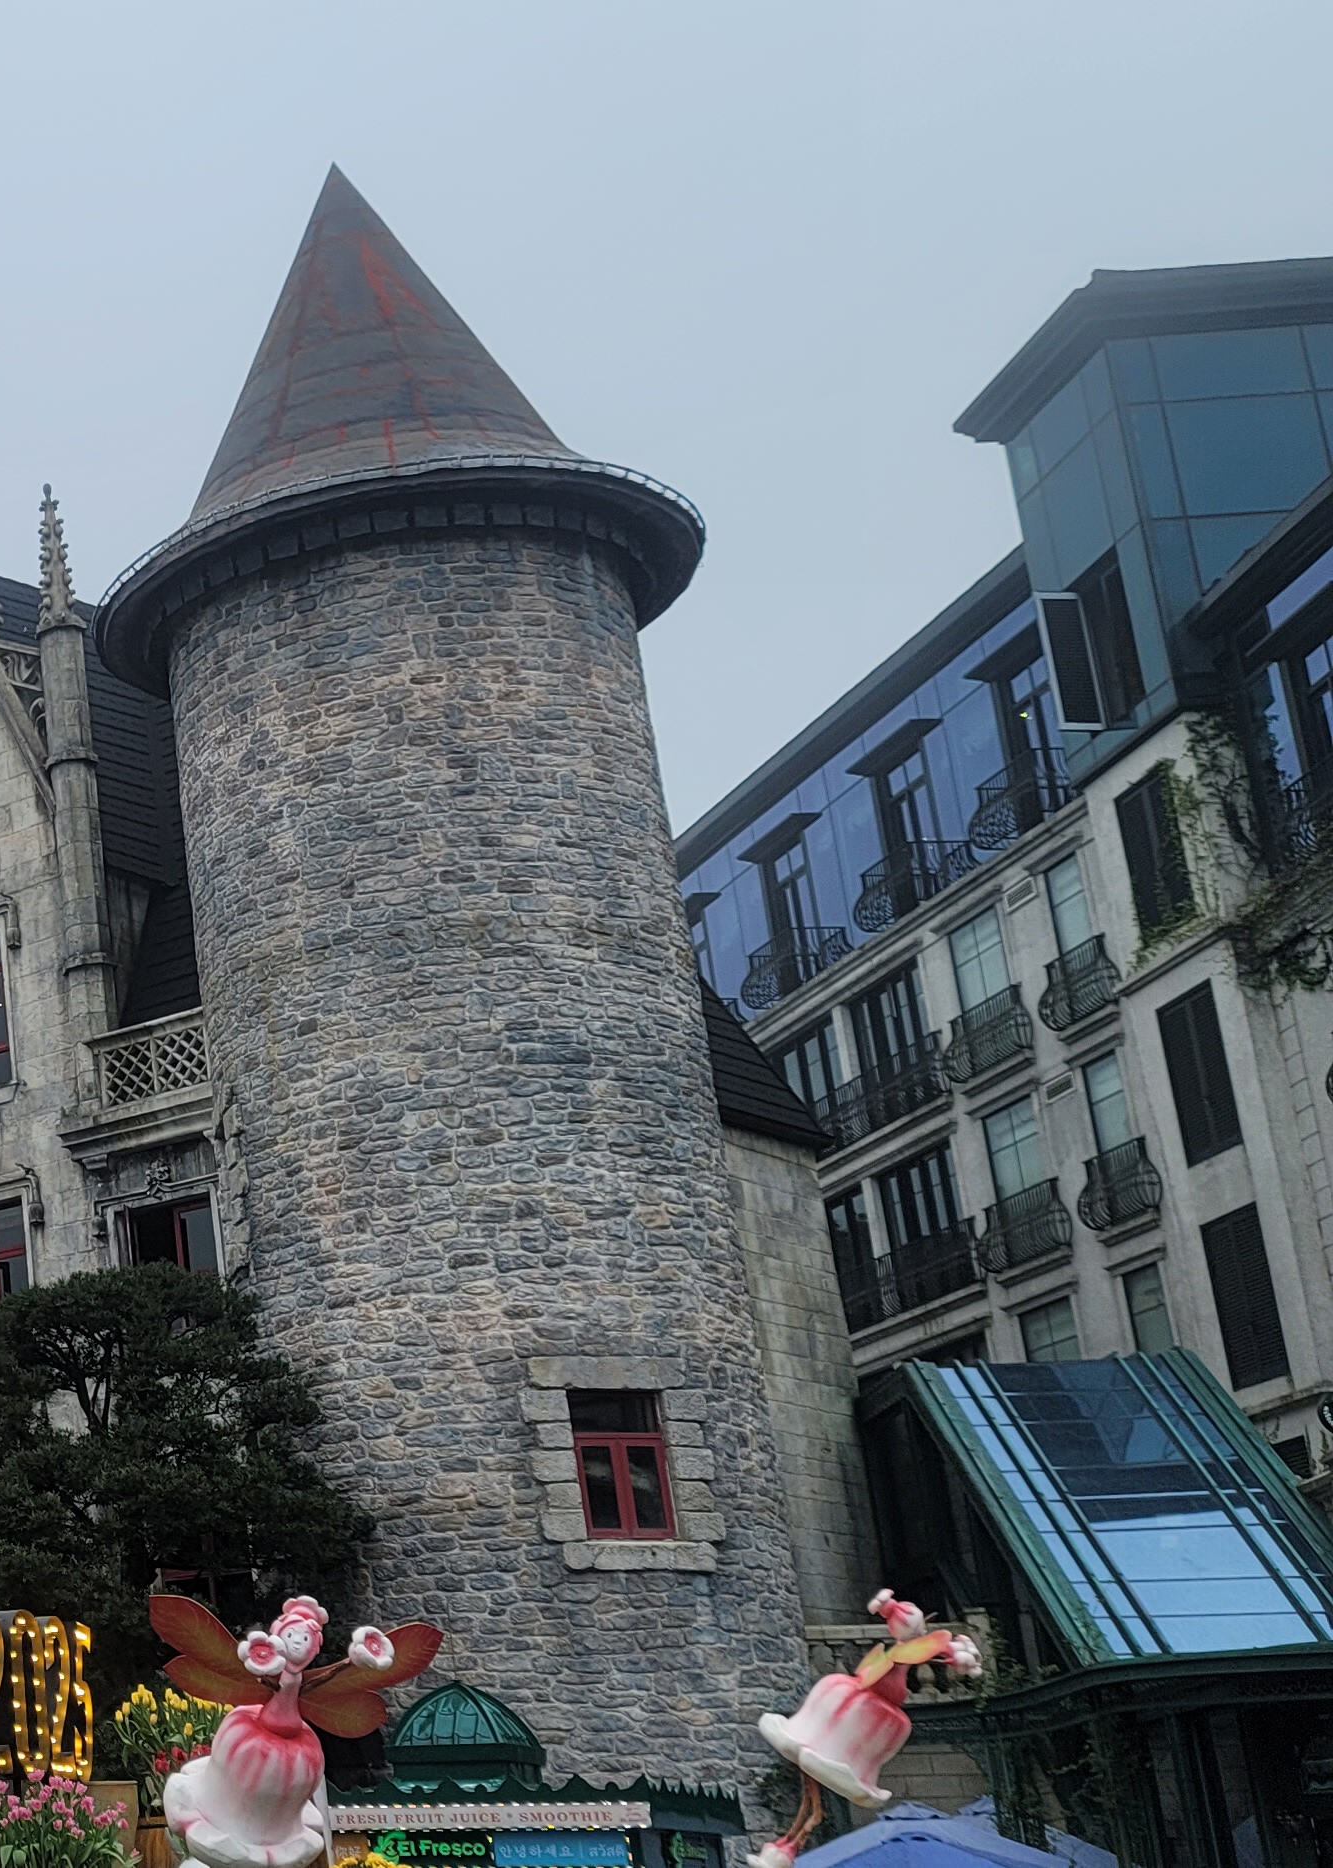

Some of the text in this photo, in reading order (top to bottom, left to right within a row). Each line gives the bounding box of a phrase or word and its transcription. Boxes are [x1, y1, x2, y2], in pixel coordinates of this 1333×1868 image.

[335, 1814, 388, 1825] FRESH
[393, 1813, 445, 1824] FRUIT
[450, 1812, 501, 1823] JUICE
[519, 1811, 613, 1823] SMOOTHIE
[397, 1840, 486, 1857] El Fresco
[499, 1844, 575, 1858] 안녕하세요
